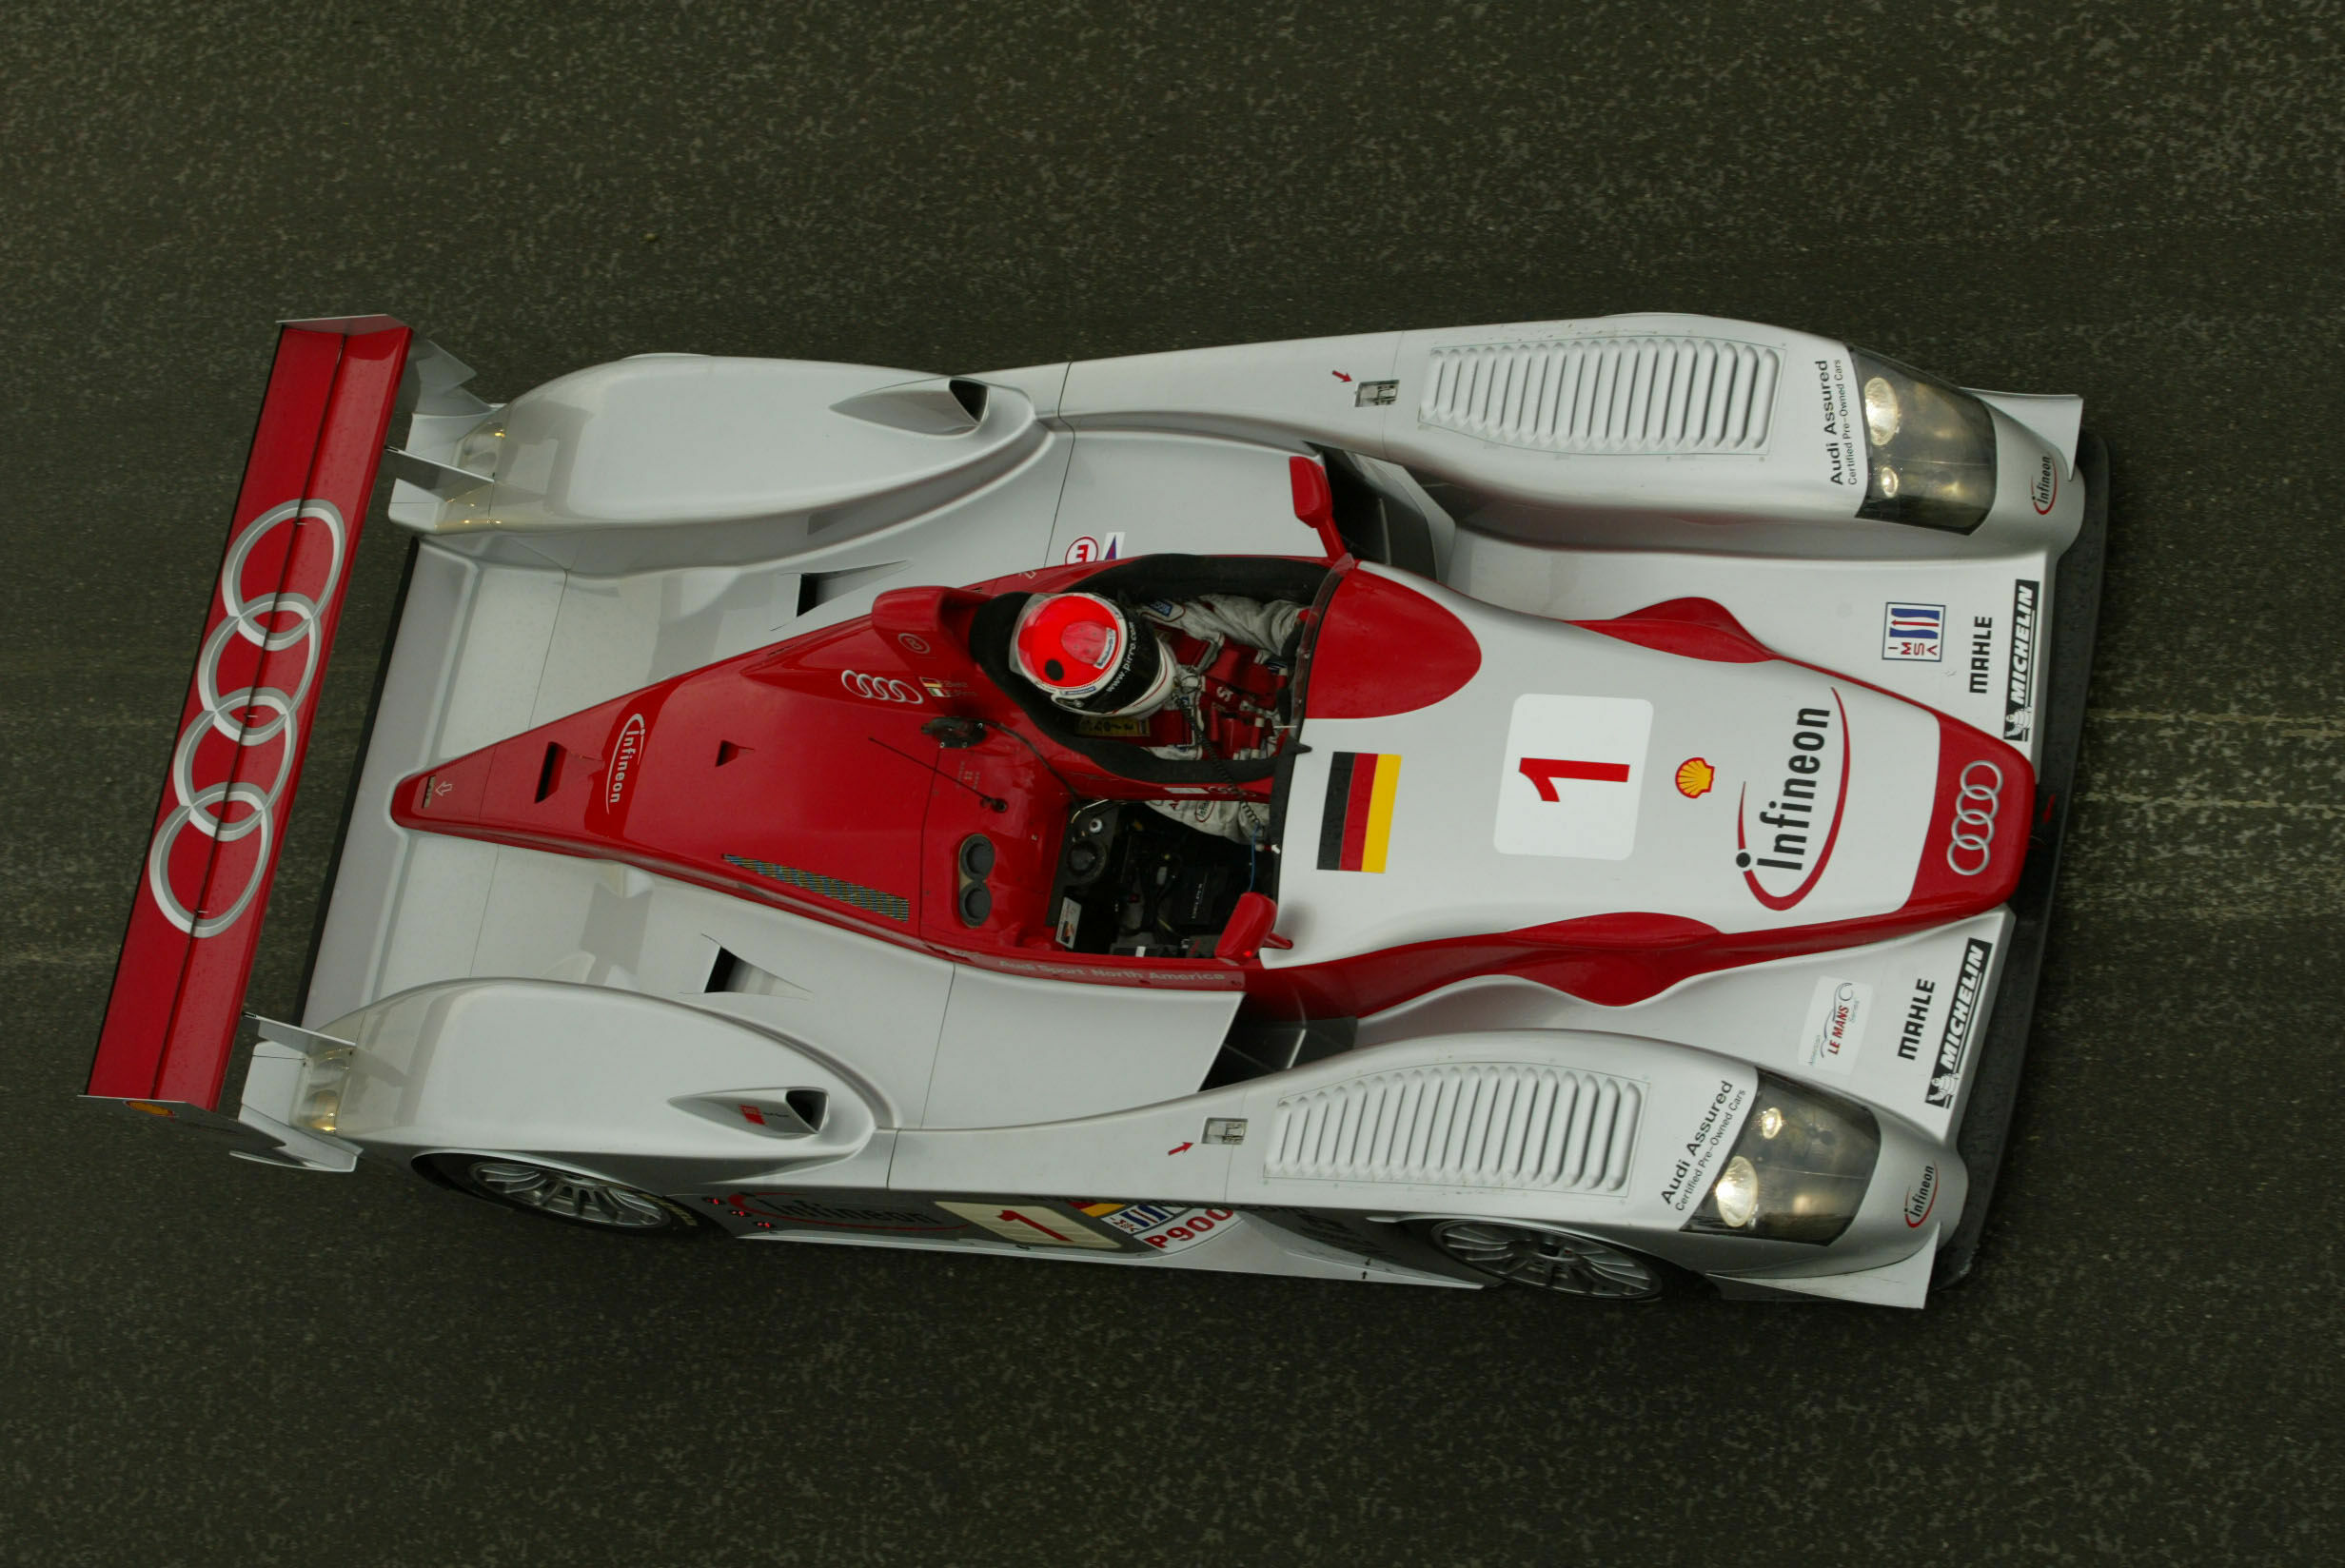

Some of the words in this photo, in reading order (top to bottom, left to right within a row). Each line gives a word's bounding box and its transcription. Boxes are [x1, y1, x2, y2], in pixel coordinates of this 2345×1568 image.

[1834, 359, 1843, 381] Cars
[1815, 361, 1838, 435] Assured
[1836, 383, 1851, 440] Pre-Owned
[1825, 441, 1843, 485] Audi
[1843, 442, 1858, 485] Certified
[1106, 621, 1137, 693] www.pirro.com
[1887, 641, 1939, 657] IMSA
[1969, 616, 1993, 694] MAHLE
[2010, 585, 2034, 705] MICHELIN
[1519, 756, 1630, 803] 1
[1736, 707, 1831, 872] Infineon
[999, 959, 1037, 971] Audi
[1038, 963, 1086, 976] Sport
[1092, 968, 1143, 979] North
[1149, 971, 1226, 981] America
[1832, 1005, 1849, 1039] MANS
[1897, 978, 1936, 1061] MAHLE
[1940, 944, 1984, 1070] MICHELIN
[1827, 1040, 1841, 1055] LE
[1661, 1158, 1691, 1205] Audi
[1686, 1080, 1733, 1157] Assured
[1675, 1168, 1704, 1211] Certified
[1698, 1112, 1733, 1168] Pre-Owned
[1728, 1089, 1746, 1111] Cars
[997, 1209, 1075, 1242] 1
[1143, 1207, 1235, 1249] P900
